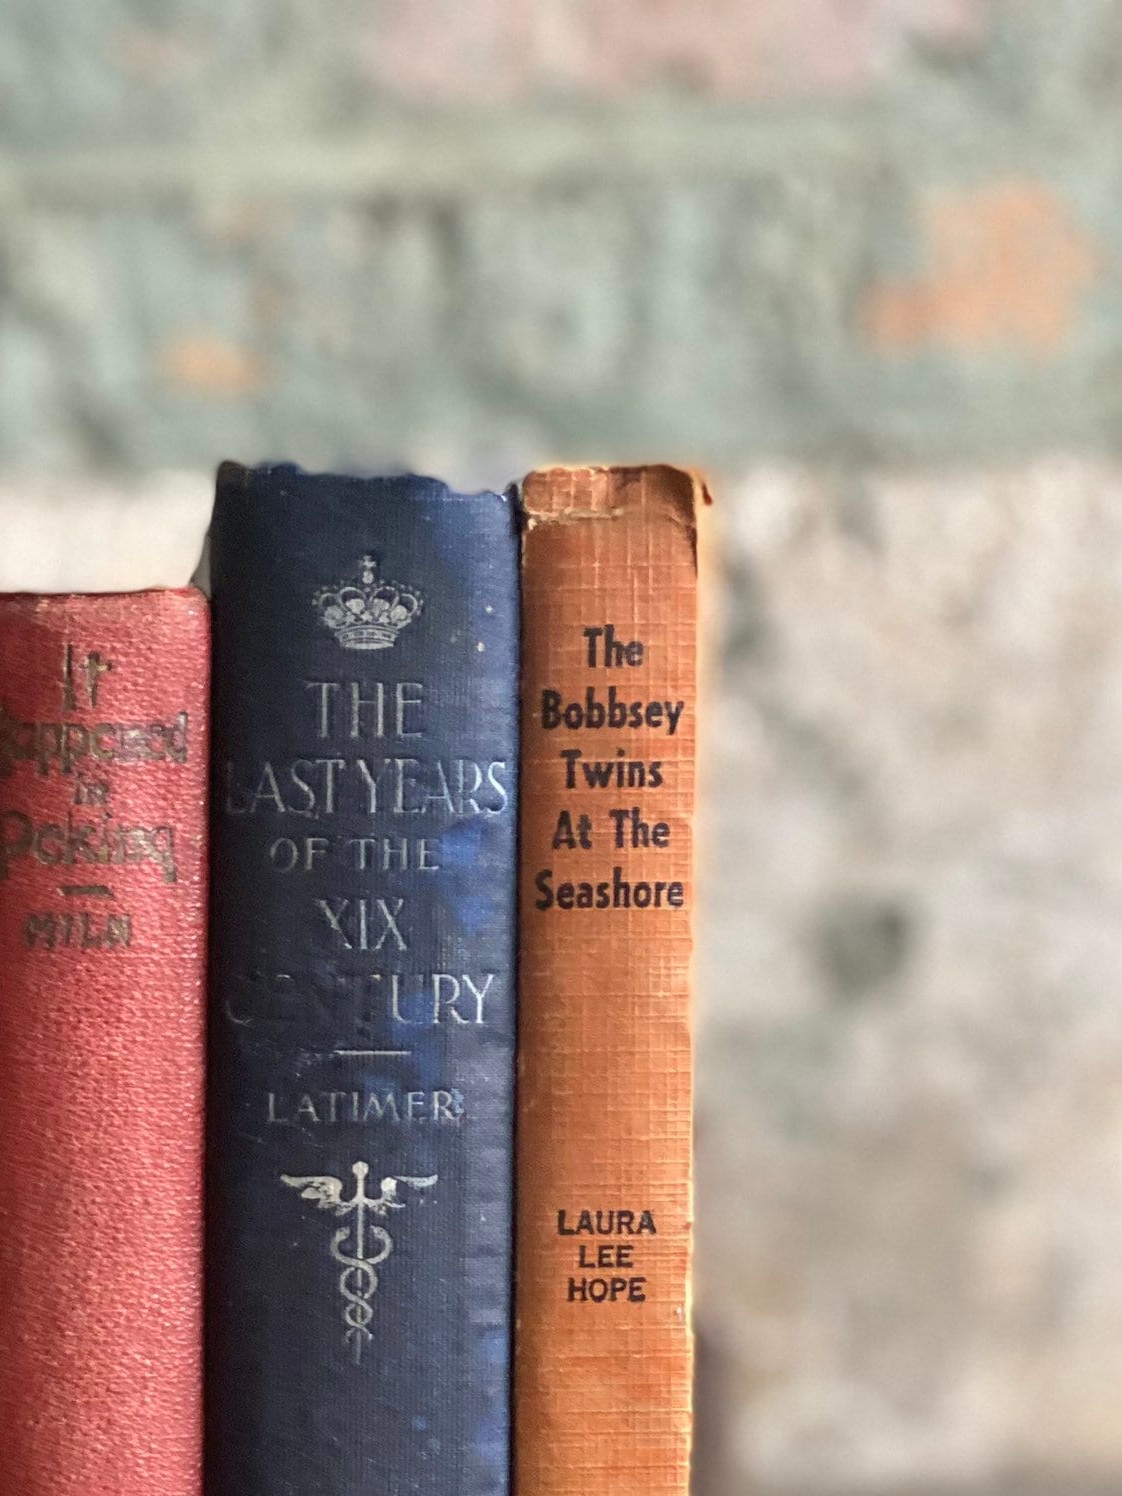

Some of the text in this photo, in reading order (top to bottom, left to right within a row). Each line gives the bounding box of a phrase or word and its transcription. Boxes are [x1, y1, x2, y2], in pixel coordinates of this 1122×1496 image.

[583, 624, 645, 669] The
[61, 643, 115, 711] It
[304, 681, 424, 739] THE
[541, 686, 686, 733] Bobbsey
[225, 758, 509, 816] LAST YEARS
[559, 748, 665, 791] Twins
[550, 810, 671, 852] At The
[269, 836, 441, 872] OF THE
[534, 867, 685, 911] Seashore
[315, 898, 408, 951] XIX
[267, 1090, 457, 1124] LATIMER
[557, 1208, 658, 1237] LAURA
[577, 1244, 634, 1270] LEE
[566, 1276, 647, 1303] HOPE
